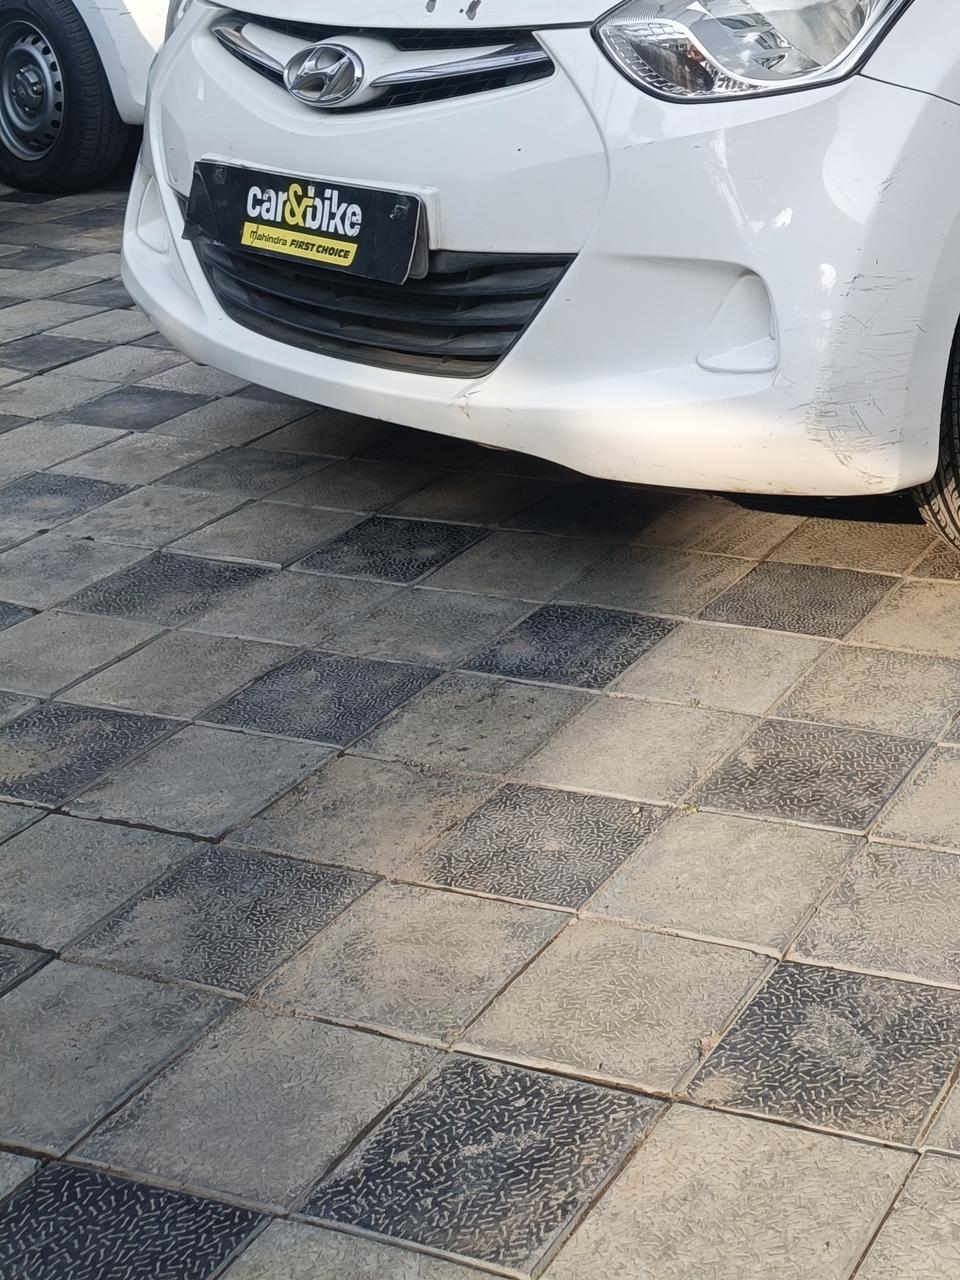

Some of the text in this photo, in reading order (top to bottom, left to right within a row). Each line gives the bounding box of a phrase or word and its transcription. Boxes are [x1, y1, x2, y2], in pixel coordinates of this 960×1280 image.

[246, 183, 363, 237] car&bike
[289, 239, 317, 253] FIRST
[316, 244, 351, 260] CHOICE
